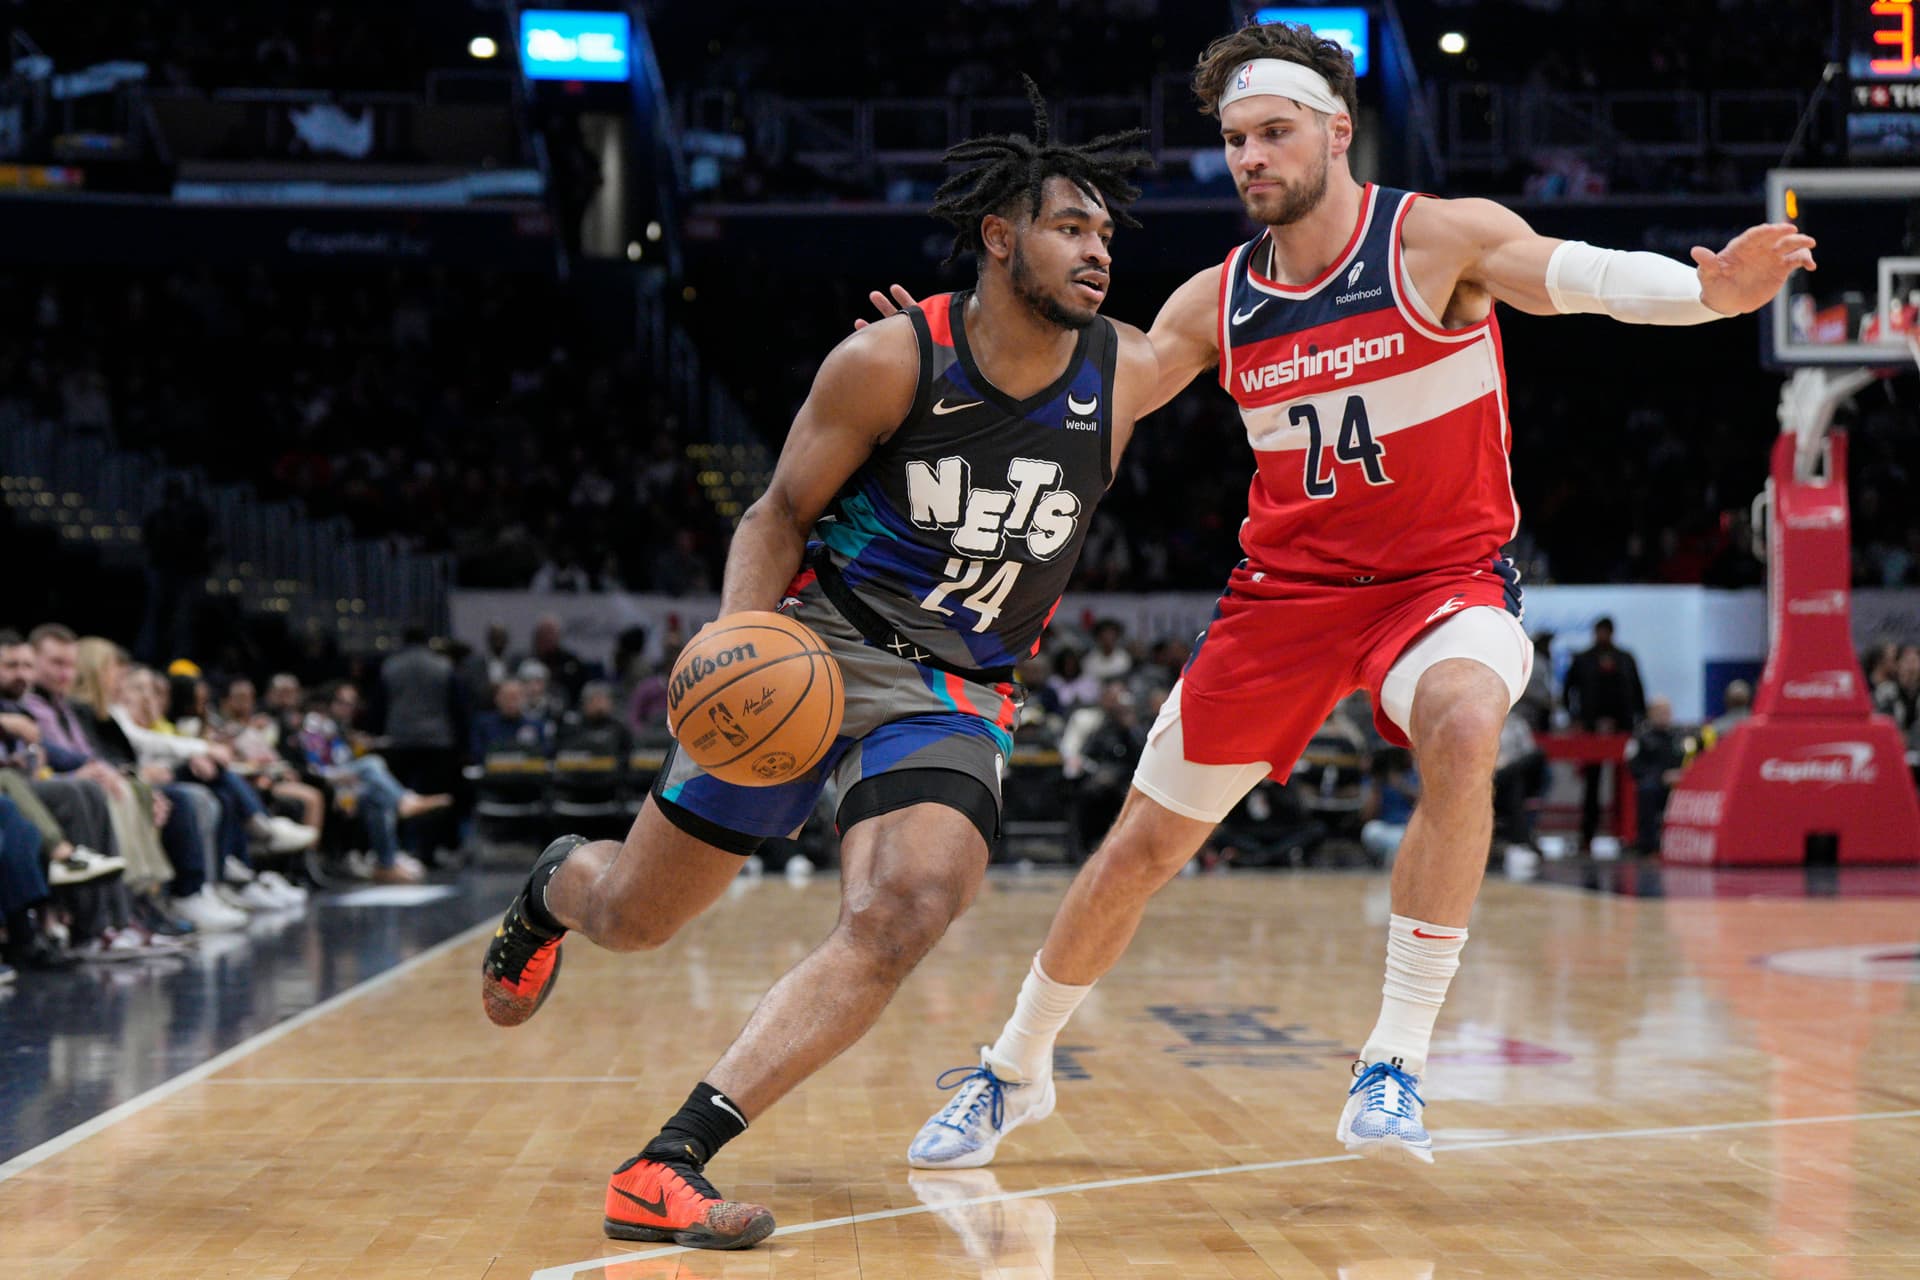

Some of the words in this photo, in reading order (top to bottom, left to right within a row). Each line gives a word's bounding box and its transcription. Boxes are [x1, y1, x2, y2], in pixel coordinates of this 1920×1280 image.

[1335, 286, 1382, 306] Robinhood
[1065, 419, 1097, 432] Webull
[1288, 394, 1395, 499] 24
[920, 558, 1023, 634] 24
[668, 641, 759, 711] Wilson
